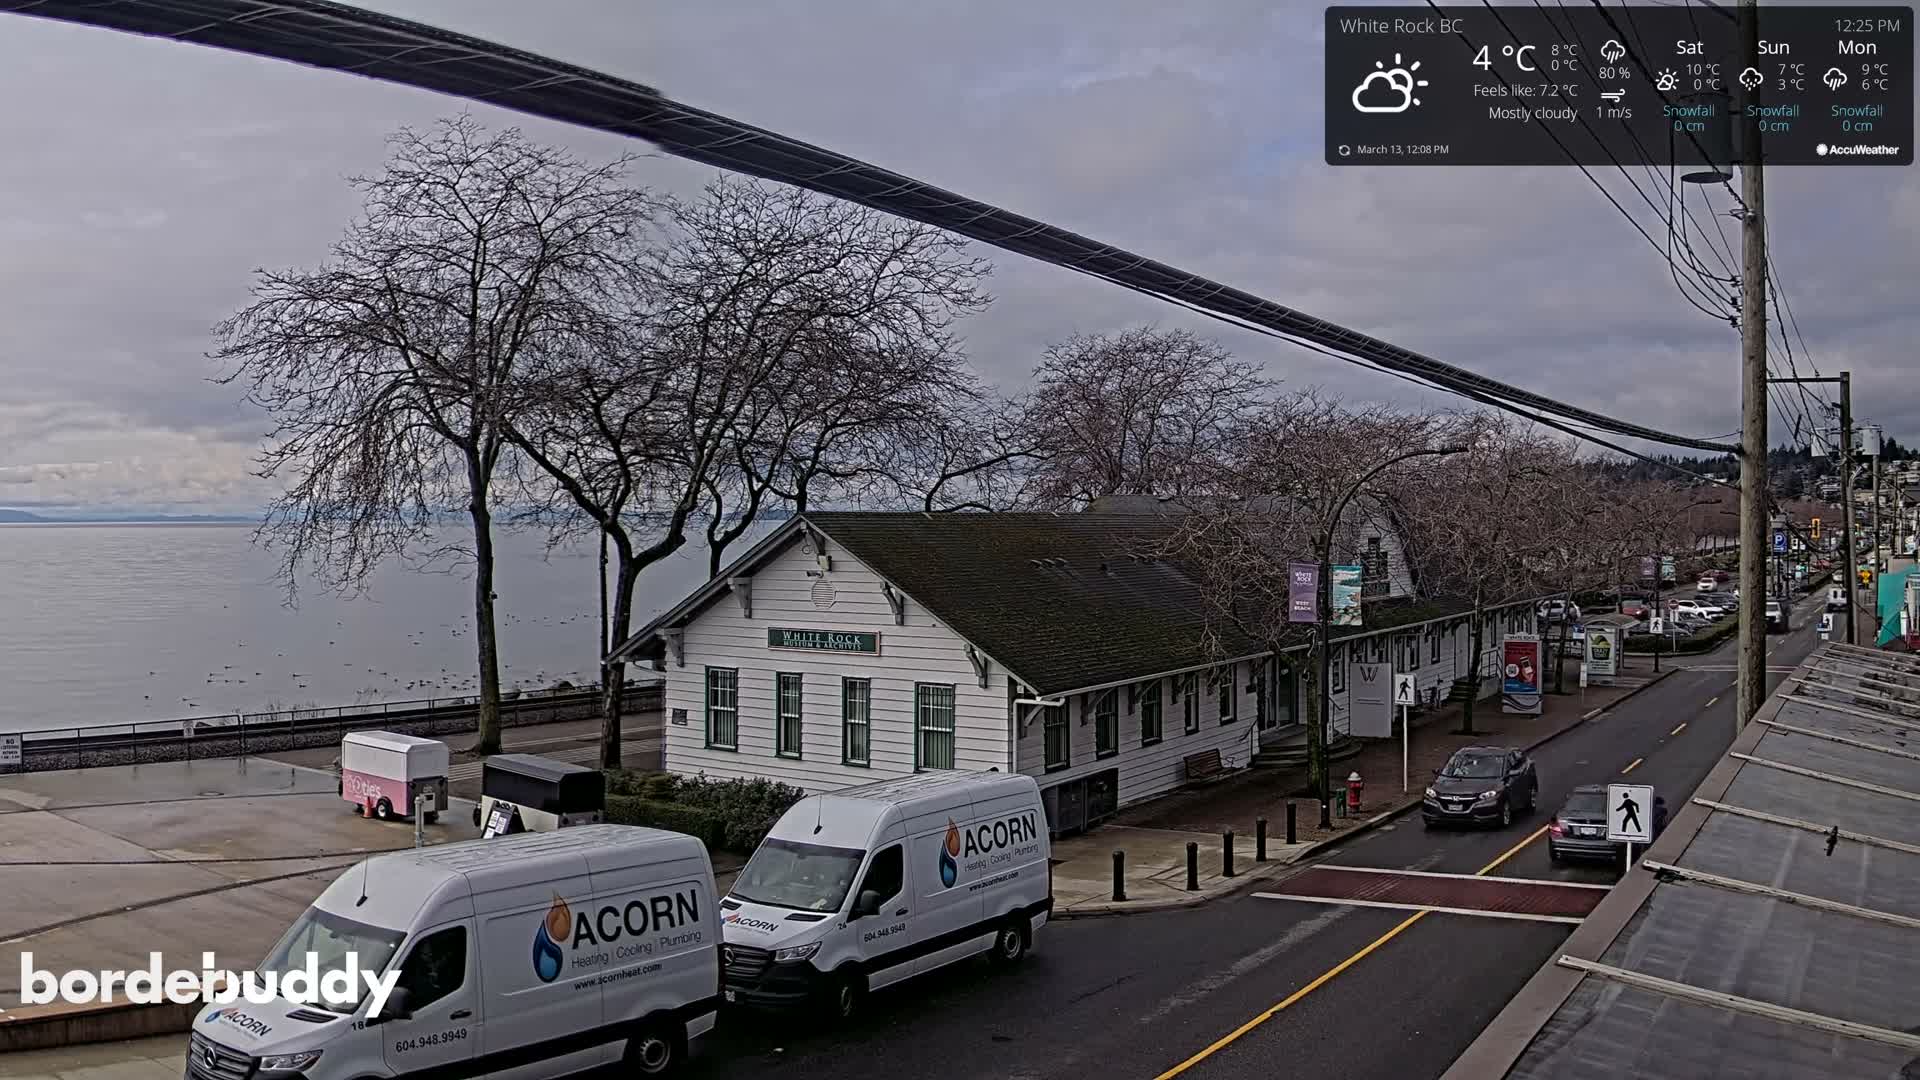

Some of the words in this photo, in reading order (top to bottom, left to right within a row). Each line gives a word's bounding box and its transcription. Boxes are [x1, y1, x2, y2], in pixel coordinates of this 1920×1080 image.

[783, 631, 821, 641] WHITE
[828, 633, 862, 644] ROCK
[824, 643, 861, 651] ARCHIVES
[964, 813, 1037, 858] ACORN
[572, 889, 699, 950] ACORN
[730, 917, 779, 932] ACORN
[571, 951, 609, 969] Heating
[616, 941, 652, 960] Cooling
[660, 930, 702, 950] Plumbing
[574, 962, 663, 991] www.acornheat.com
[224, 1011, 273, 1037] ACORN
[395, 1028, 468, 1053] 604.948.9949
